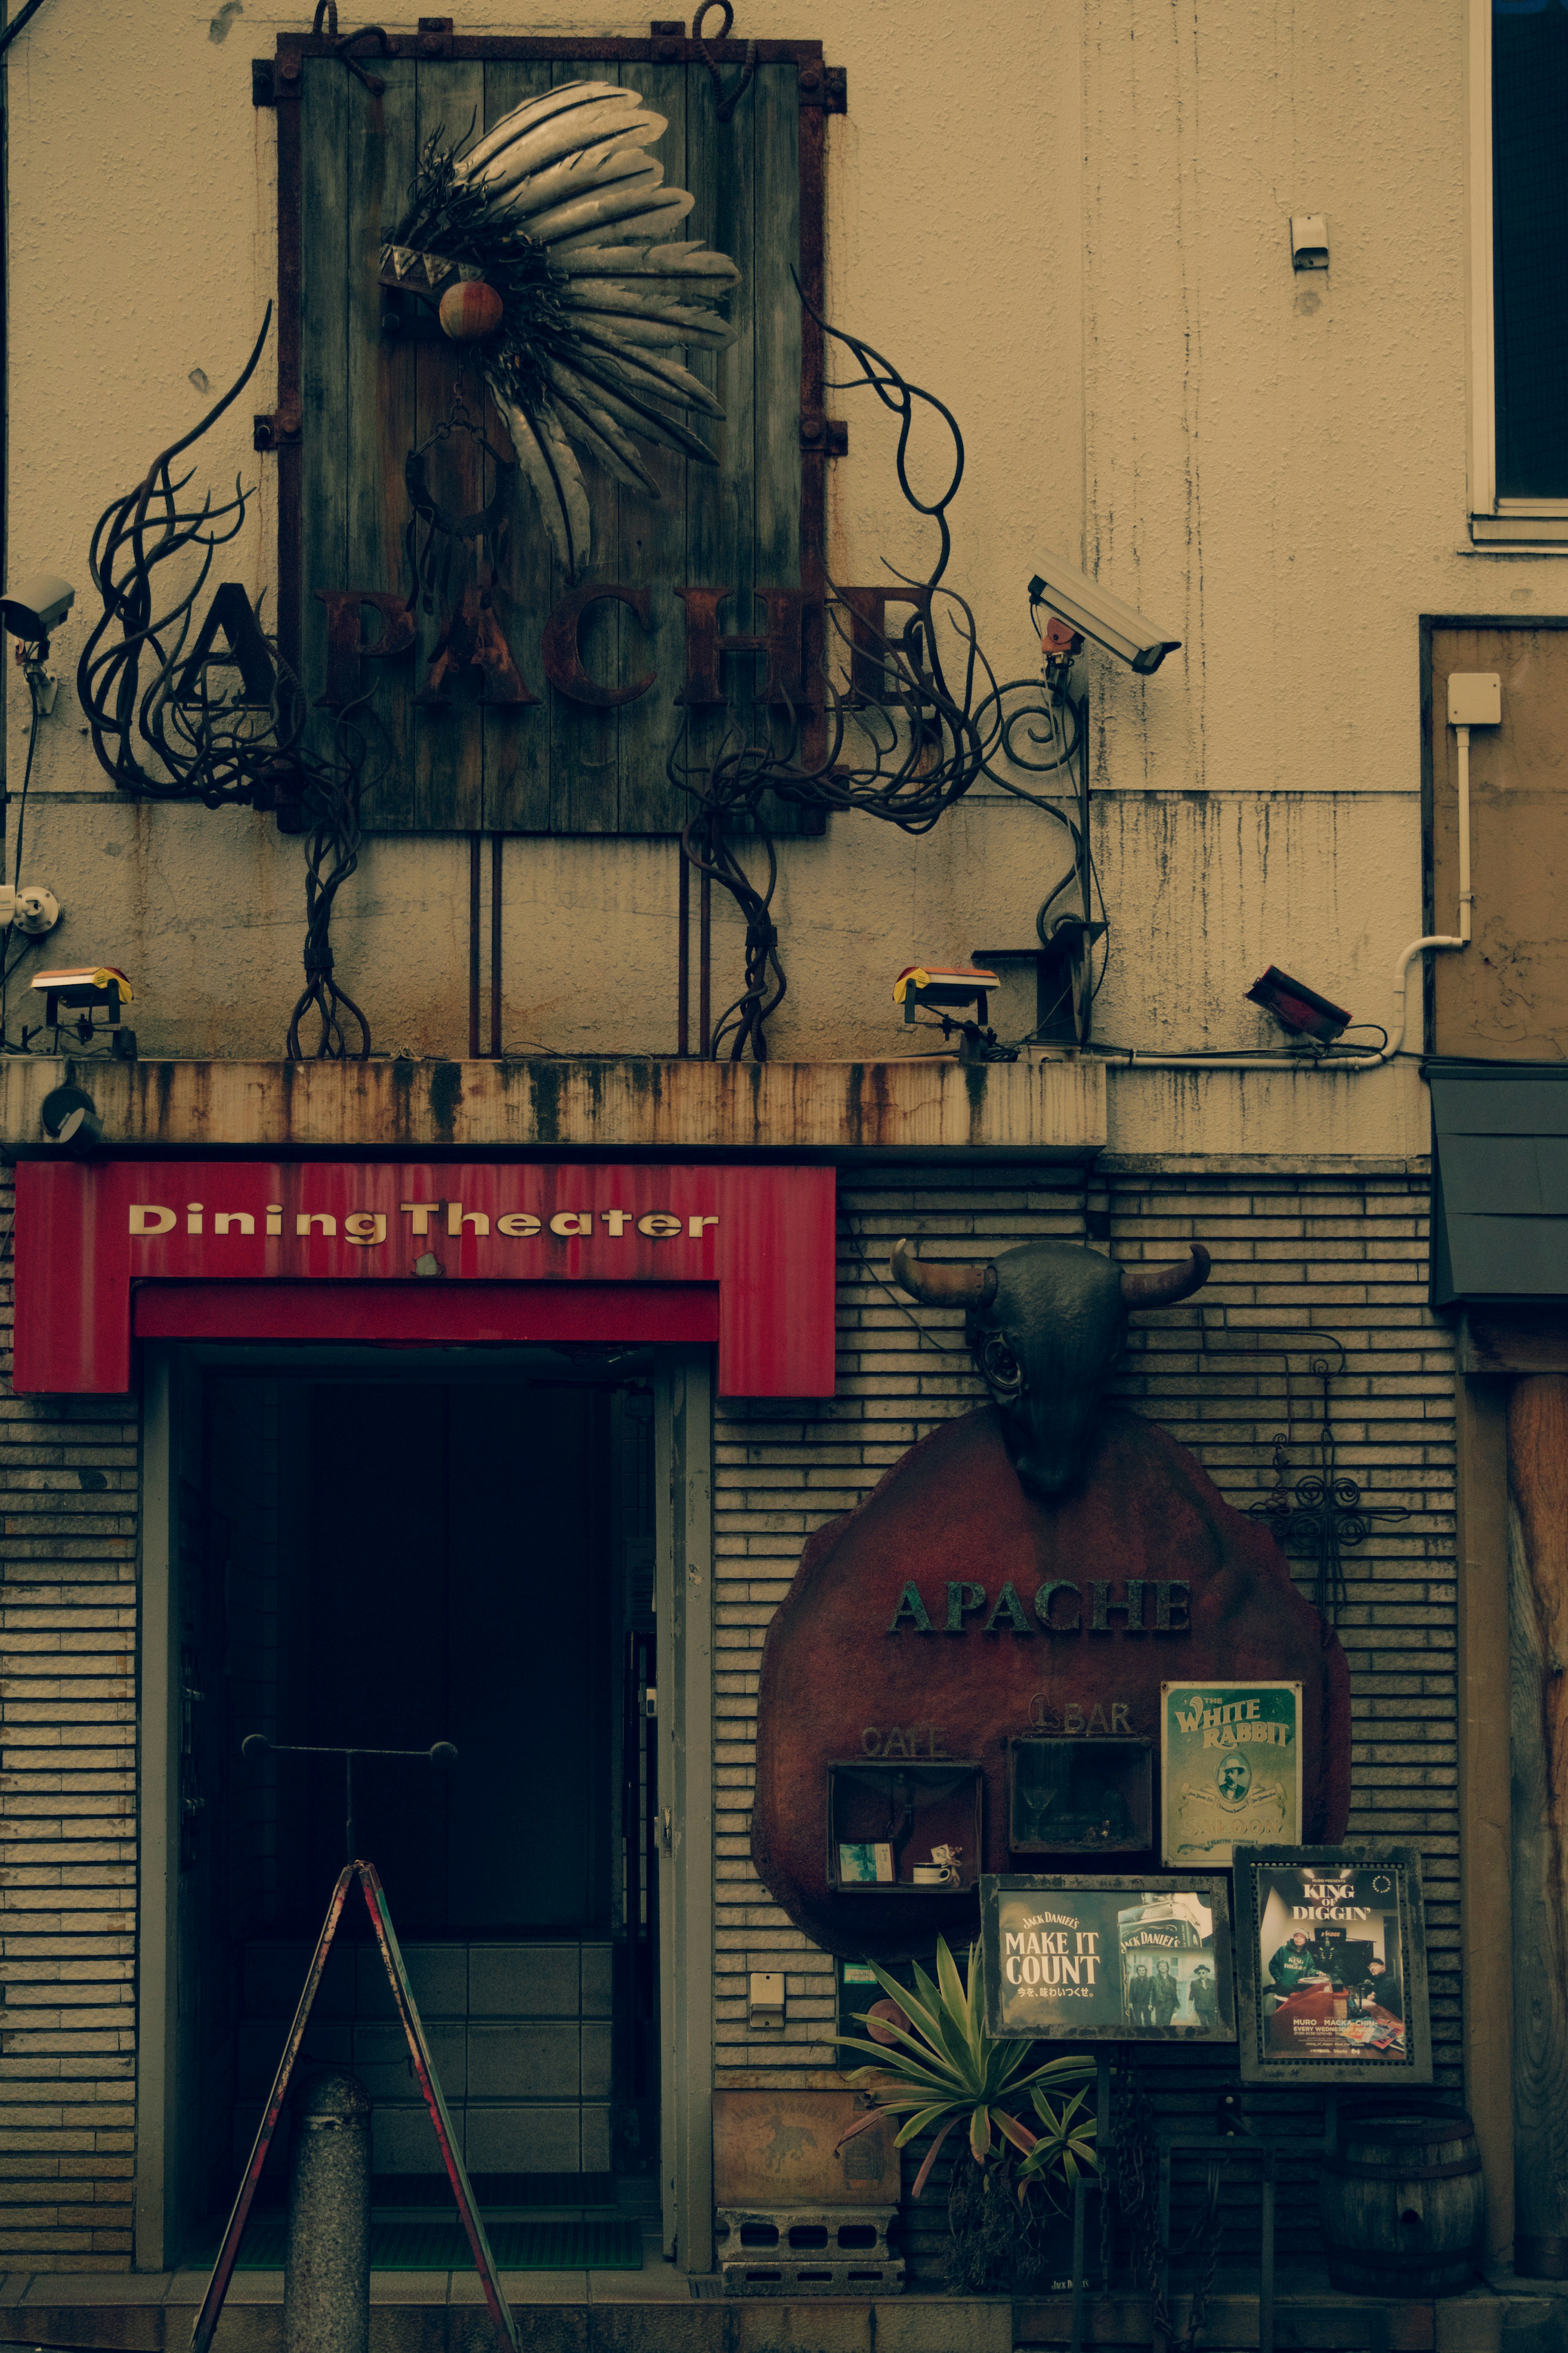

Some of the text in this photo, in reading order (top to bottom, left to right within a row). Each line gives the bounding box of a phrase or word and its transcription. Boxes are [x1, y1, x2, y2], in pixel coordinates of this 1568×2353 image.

[163, 583, 933, 707] APACHE
[886, 1579, 1191, 1632] APACHE
[1064, 1702, 1133, 1733] BAR
[1175, 1696, 1261, 1733] WHITE
[861, 1727, 949, 1756] CAFE
[1203, 1721, 1289, 1750] RABBIT
[1182, 1818, 1282, 1836] SALOON
[1303, 1884, 1356, 1899] KING
[1022, 1911, 1080, 1930] JACK DANIEL'S
[1292, 1906, 1371, 1920] DIGGIN'
[1005, 1932, 1099, 1955] MAKE IT
[1006, 1956, 1100, 1985] COUNT
[1017, 1987, 1094, 1997] 今を、味わいつくせ。
[1051, 2280, 1066, 2290] JACK
